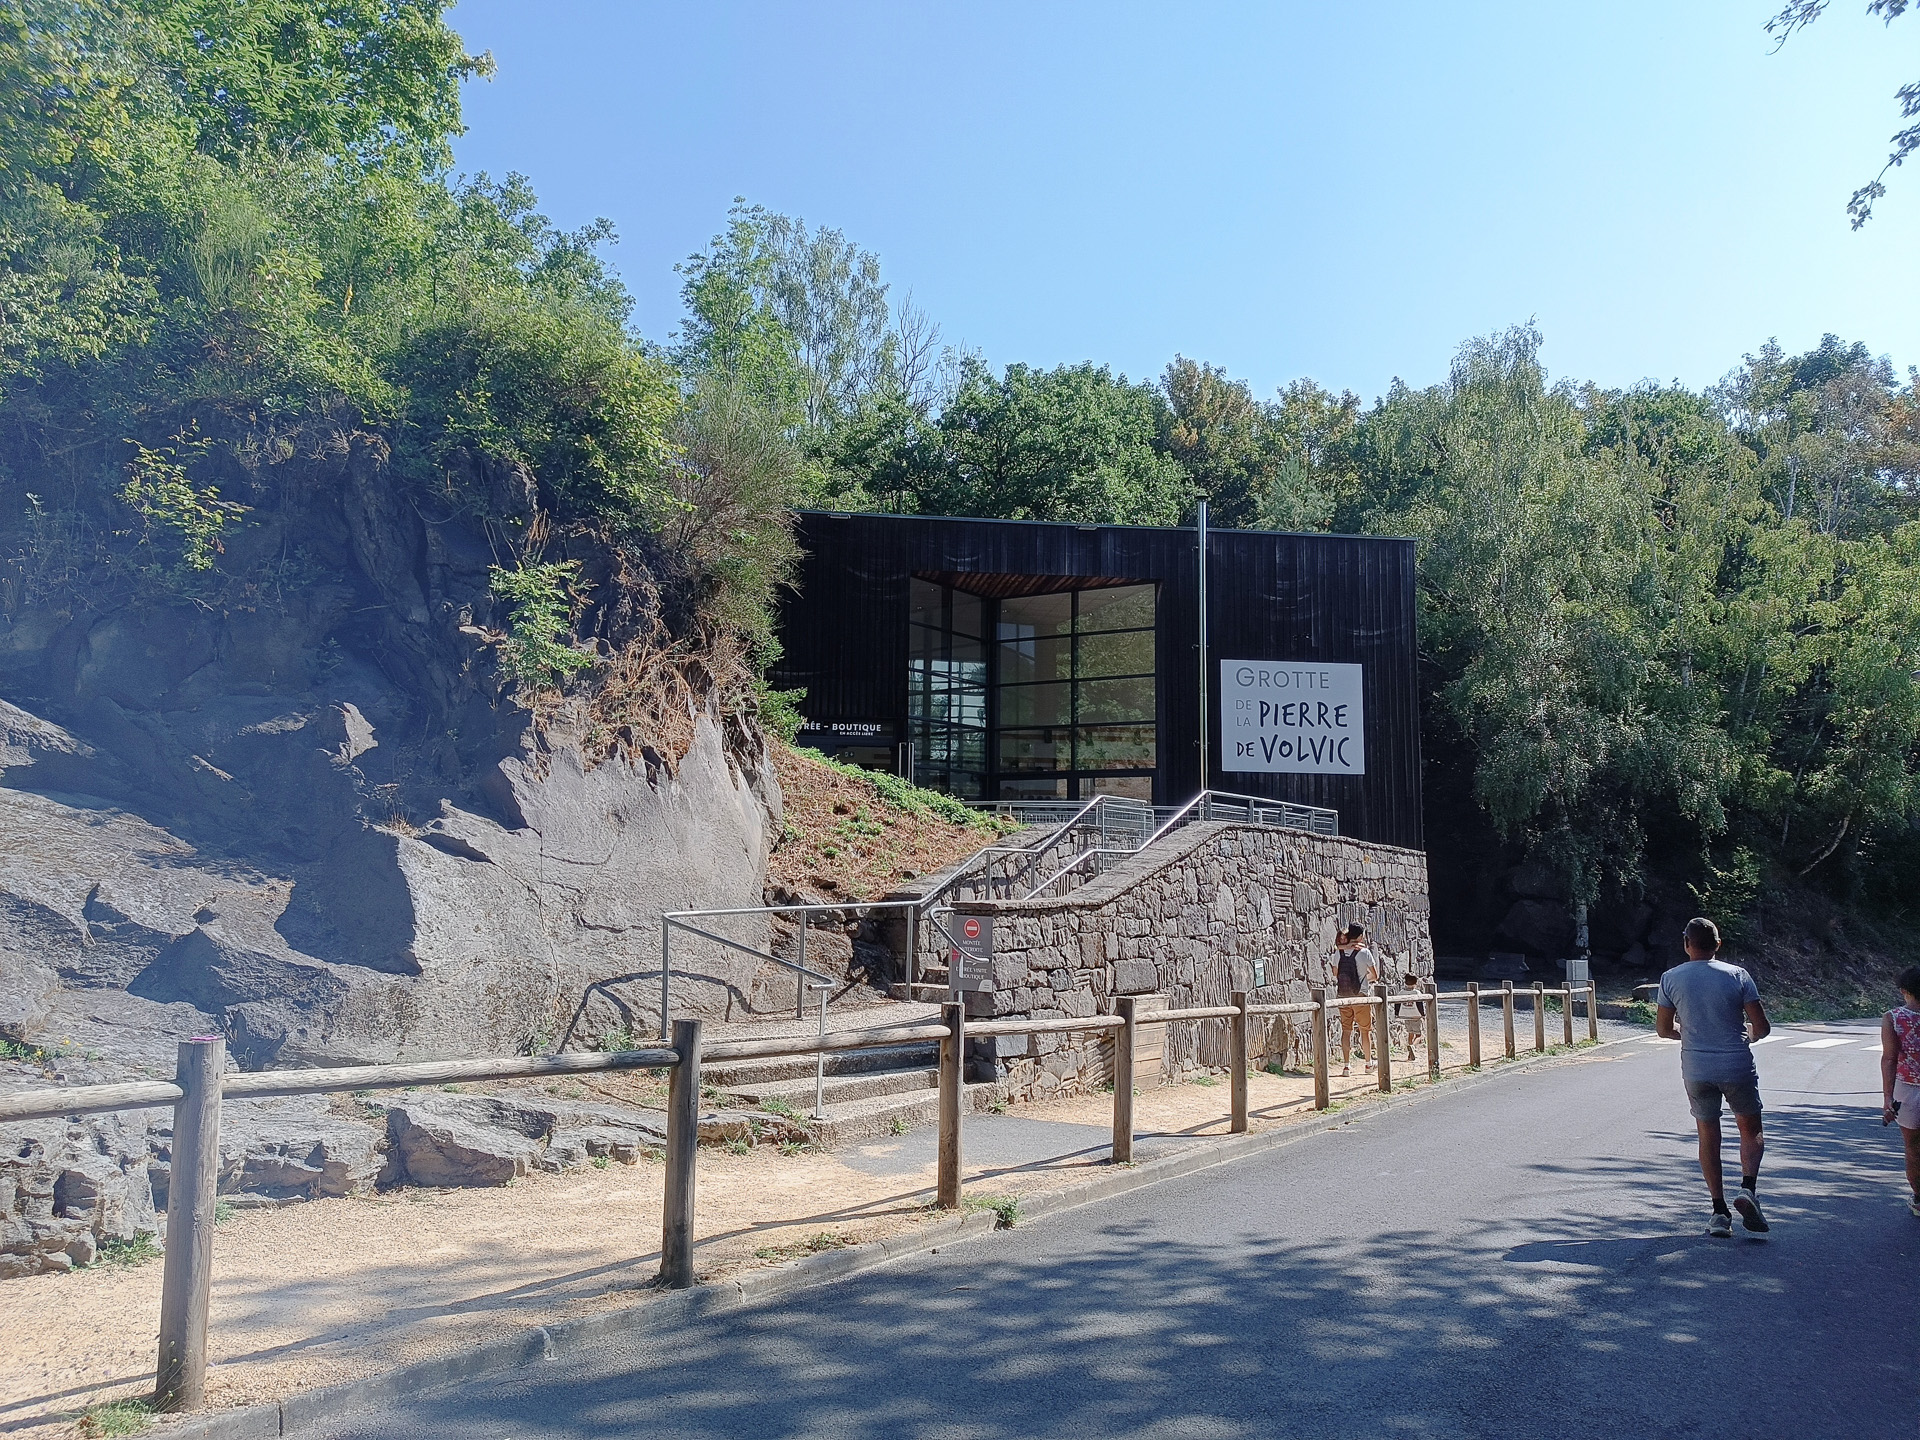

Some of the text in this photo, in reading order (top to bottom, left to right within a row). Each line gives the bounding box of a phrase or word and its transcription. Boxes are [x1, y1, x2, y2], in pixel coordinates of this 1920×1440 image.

[1235, 667, 1330, 689] GROTTE
[1235, 700, 1252, 710] DE
[1236, 716, 1251, 727] LA
[1259, 700, 1348, 729] PIERRE
[803, 720, 821, 731] RÉE
[832, 723, 882, 732] BOUTIQUE
[1236, 734, 1351, 767] DE VOLVIC
